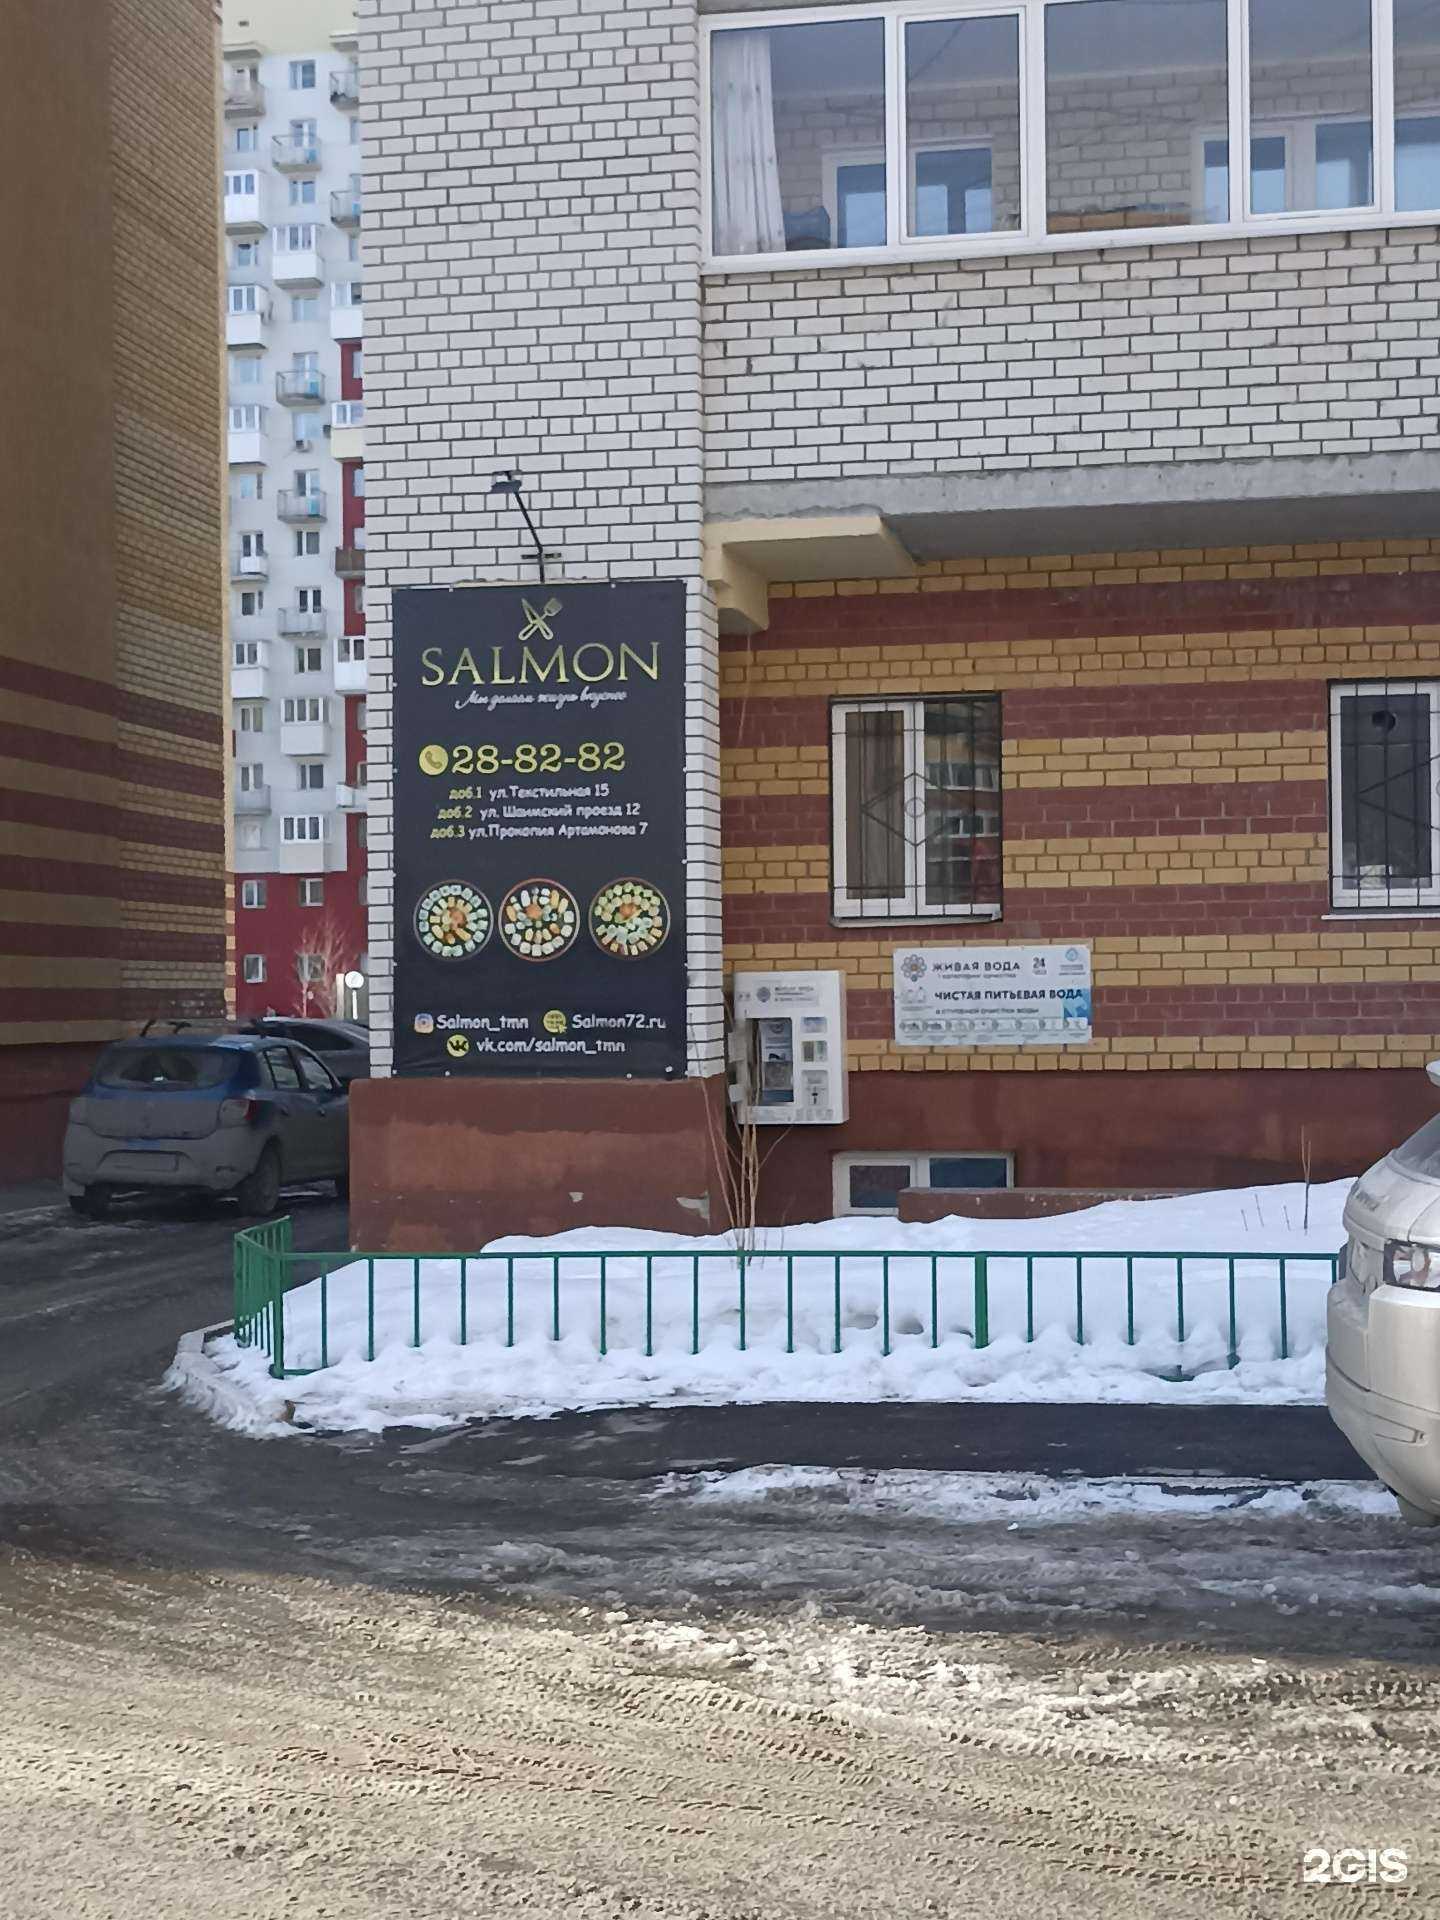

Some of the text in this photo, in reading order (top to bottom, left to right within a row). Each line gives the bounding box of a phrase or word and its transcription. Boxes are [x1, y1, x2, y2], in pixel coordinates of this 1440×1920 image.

[420, 641, 660, 686] SALMON
[451, 741, 626, 774] 28-82-82
[594, 783, 610, 797] 15
[479, 807, 500, 821] ул.
[576, 806, 623, 819] проезд
[625, 802, 641, 816] 12
[558, 824, 637, 839] Артамонова
[638, 821, 649, 835] 7
[932, 962, 1021, 972] ЖИВАЯ ВОДА
[934, 988, 1083, 1001] ЧИСТАЯ ПИТЬЕВАЯ ВОДА
[436, 1014, 530, 1031] Salmon_tmn
[571, 1013, 667, 1030] Salmon72.ru
[476, 1036, 626, 1055] vk.com/salmon_tmn
